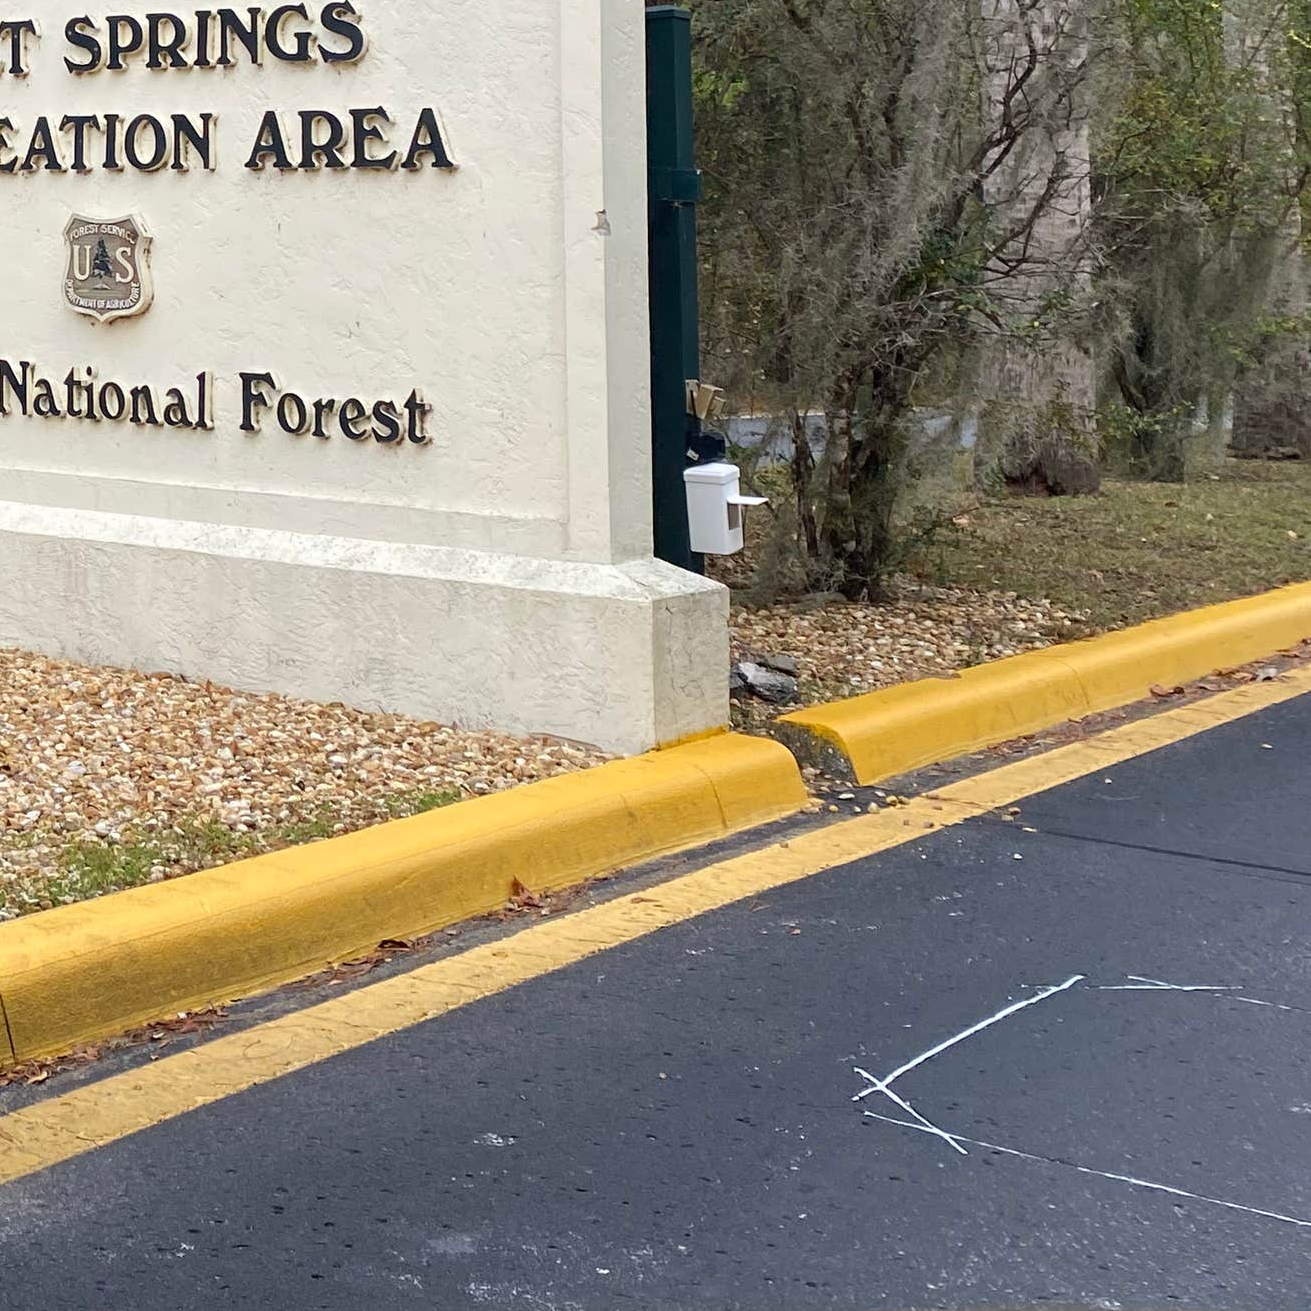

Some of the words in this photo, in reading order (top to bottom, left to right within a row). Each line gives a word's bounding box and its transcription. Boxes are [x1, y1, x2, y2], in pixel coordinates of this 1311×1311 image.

[64, 0, 364, 75] SPRINGS
[245, 106, 454, 172] AREA
[70, 224, 99, 241] FOREST
[239, 373, 431, 444] Forest
